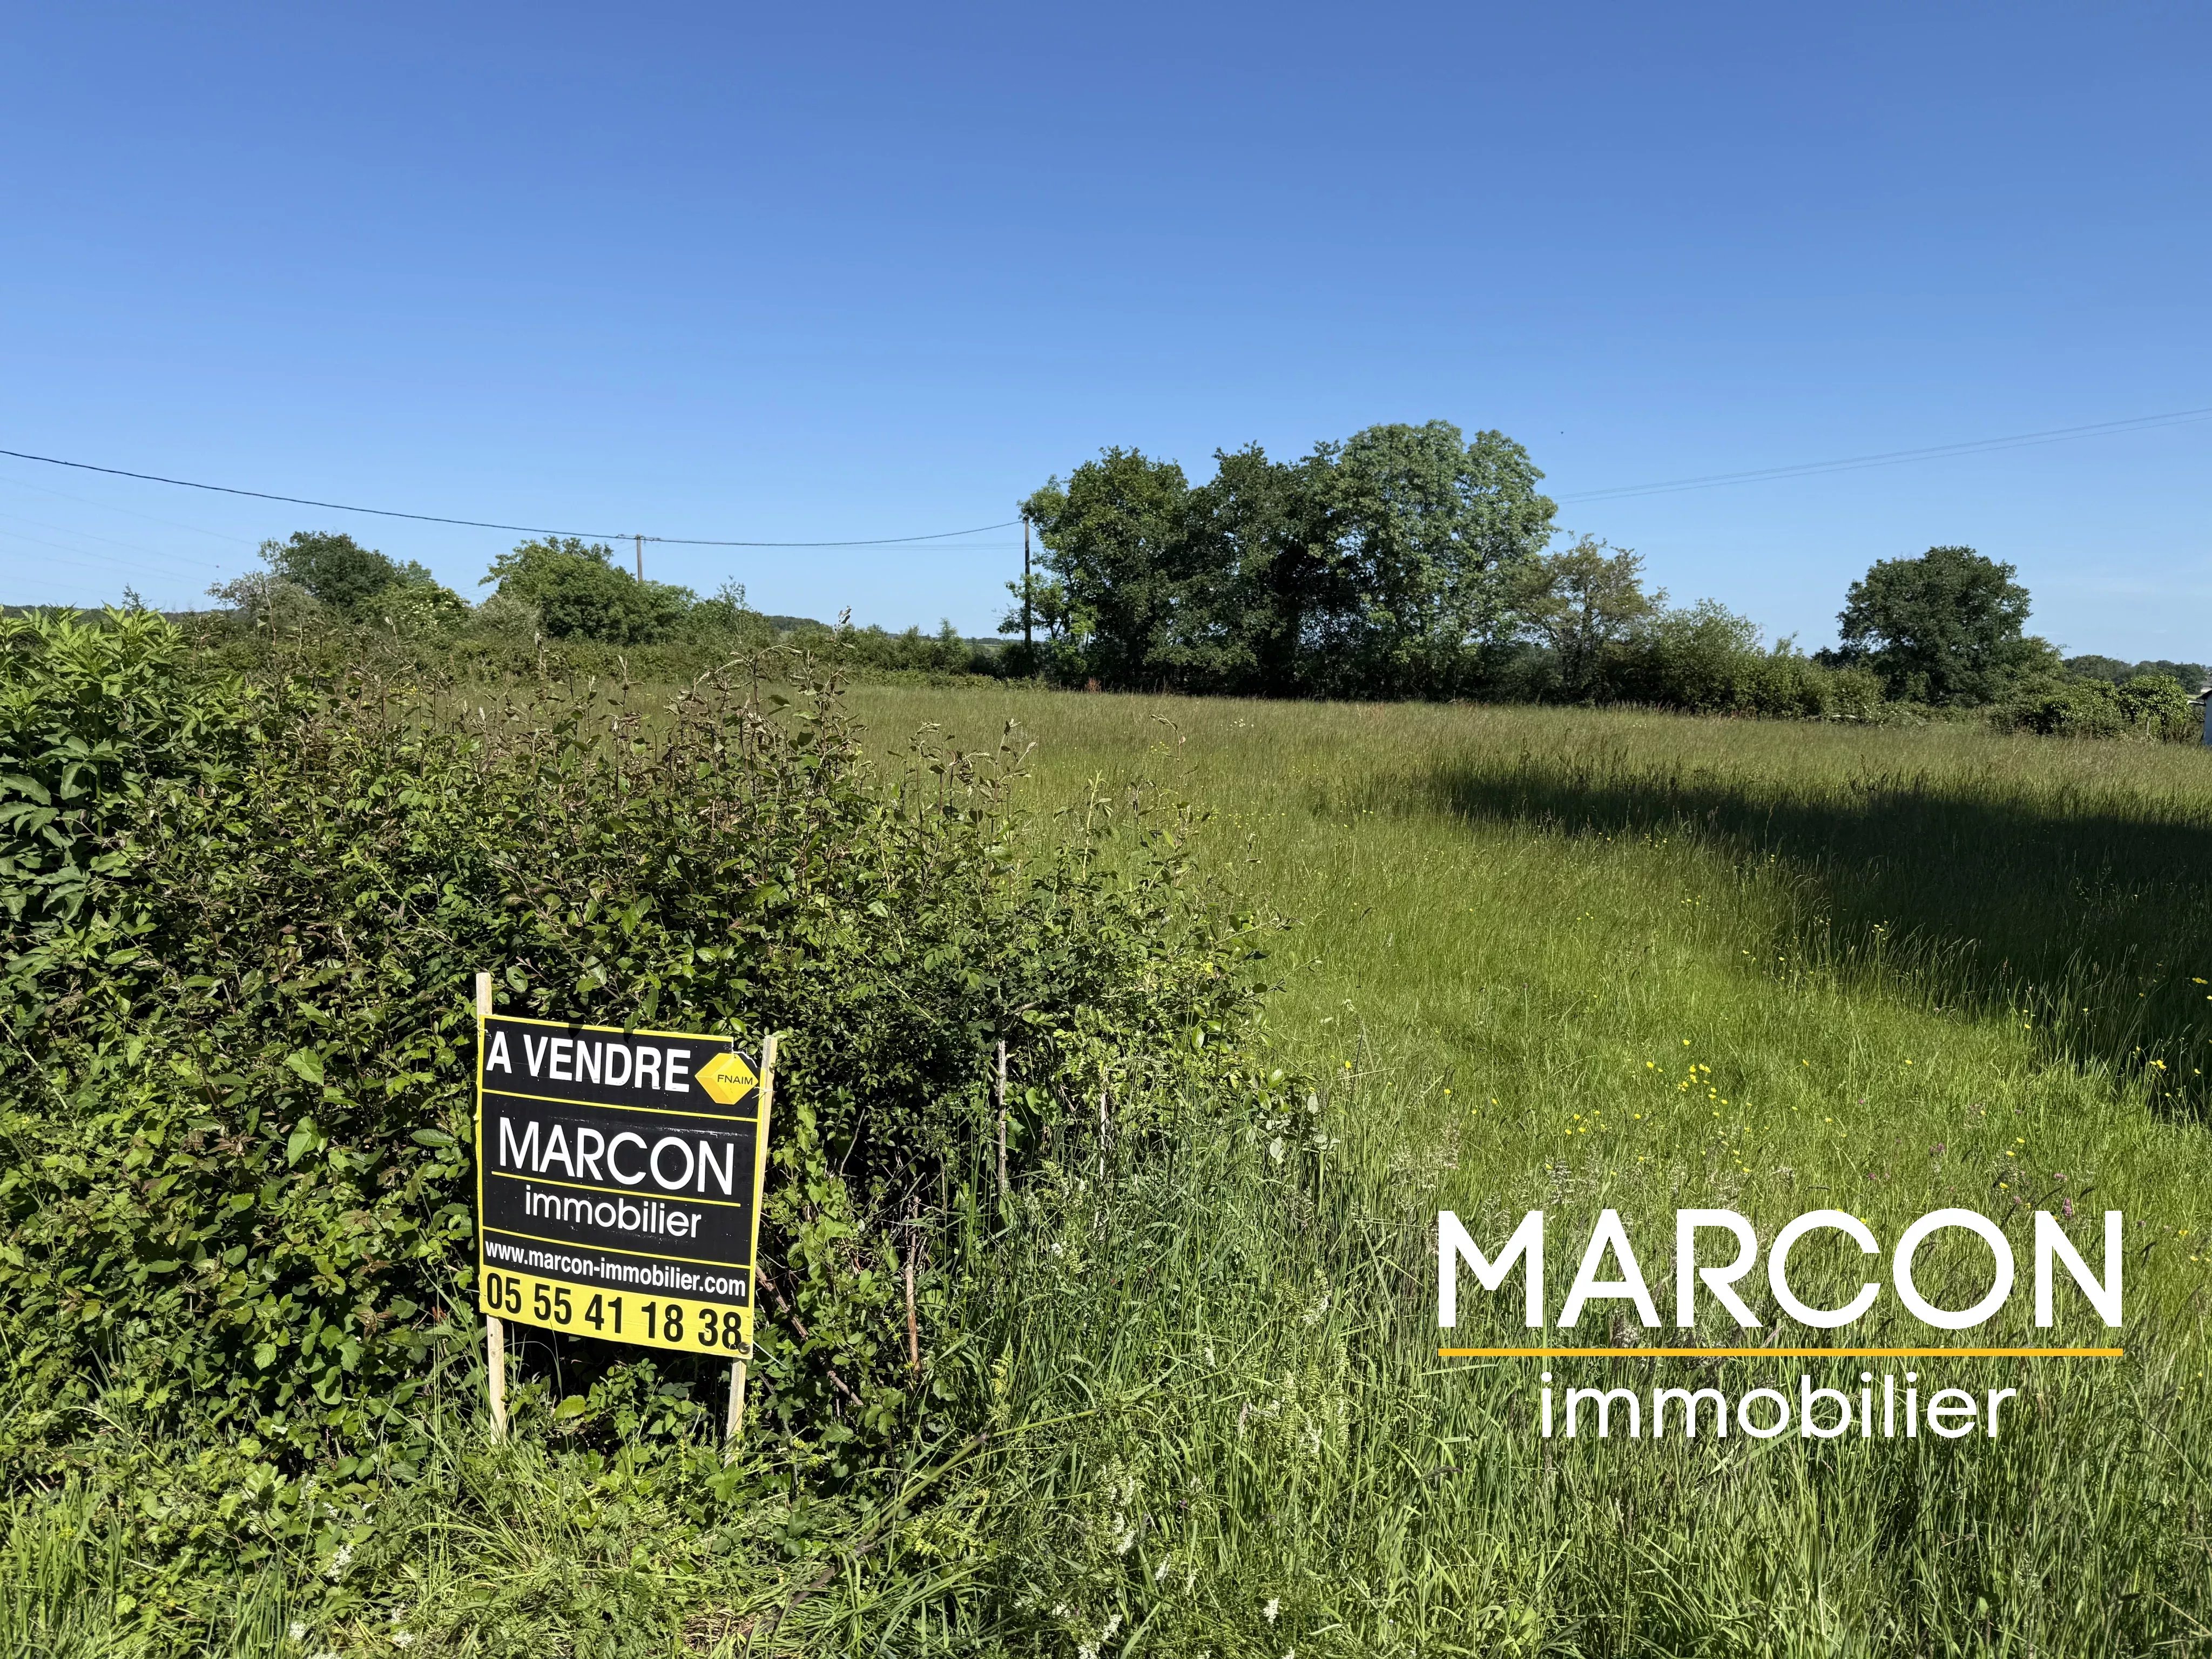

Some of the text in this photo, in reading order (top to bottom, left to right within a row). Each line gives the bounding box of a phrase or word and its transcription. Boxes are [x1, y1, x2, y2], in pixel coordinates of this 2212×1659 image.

[486, 1031, 691, 1092] A VENDRE
[717, 1074, 753, 1086] FNAIM
[500, 1117, 734, 1196] MARCON
[525, 1185, 702, 1238] immobilier
[485, 1240, 746, 1297] www.marcon-immobilier.com
[487, 1272, 742, 1350] 05 55 41 18 38
